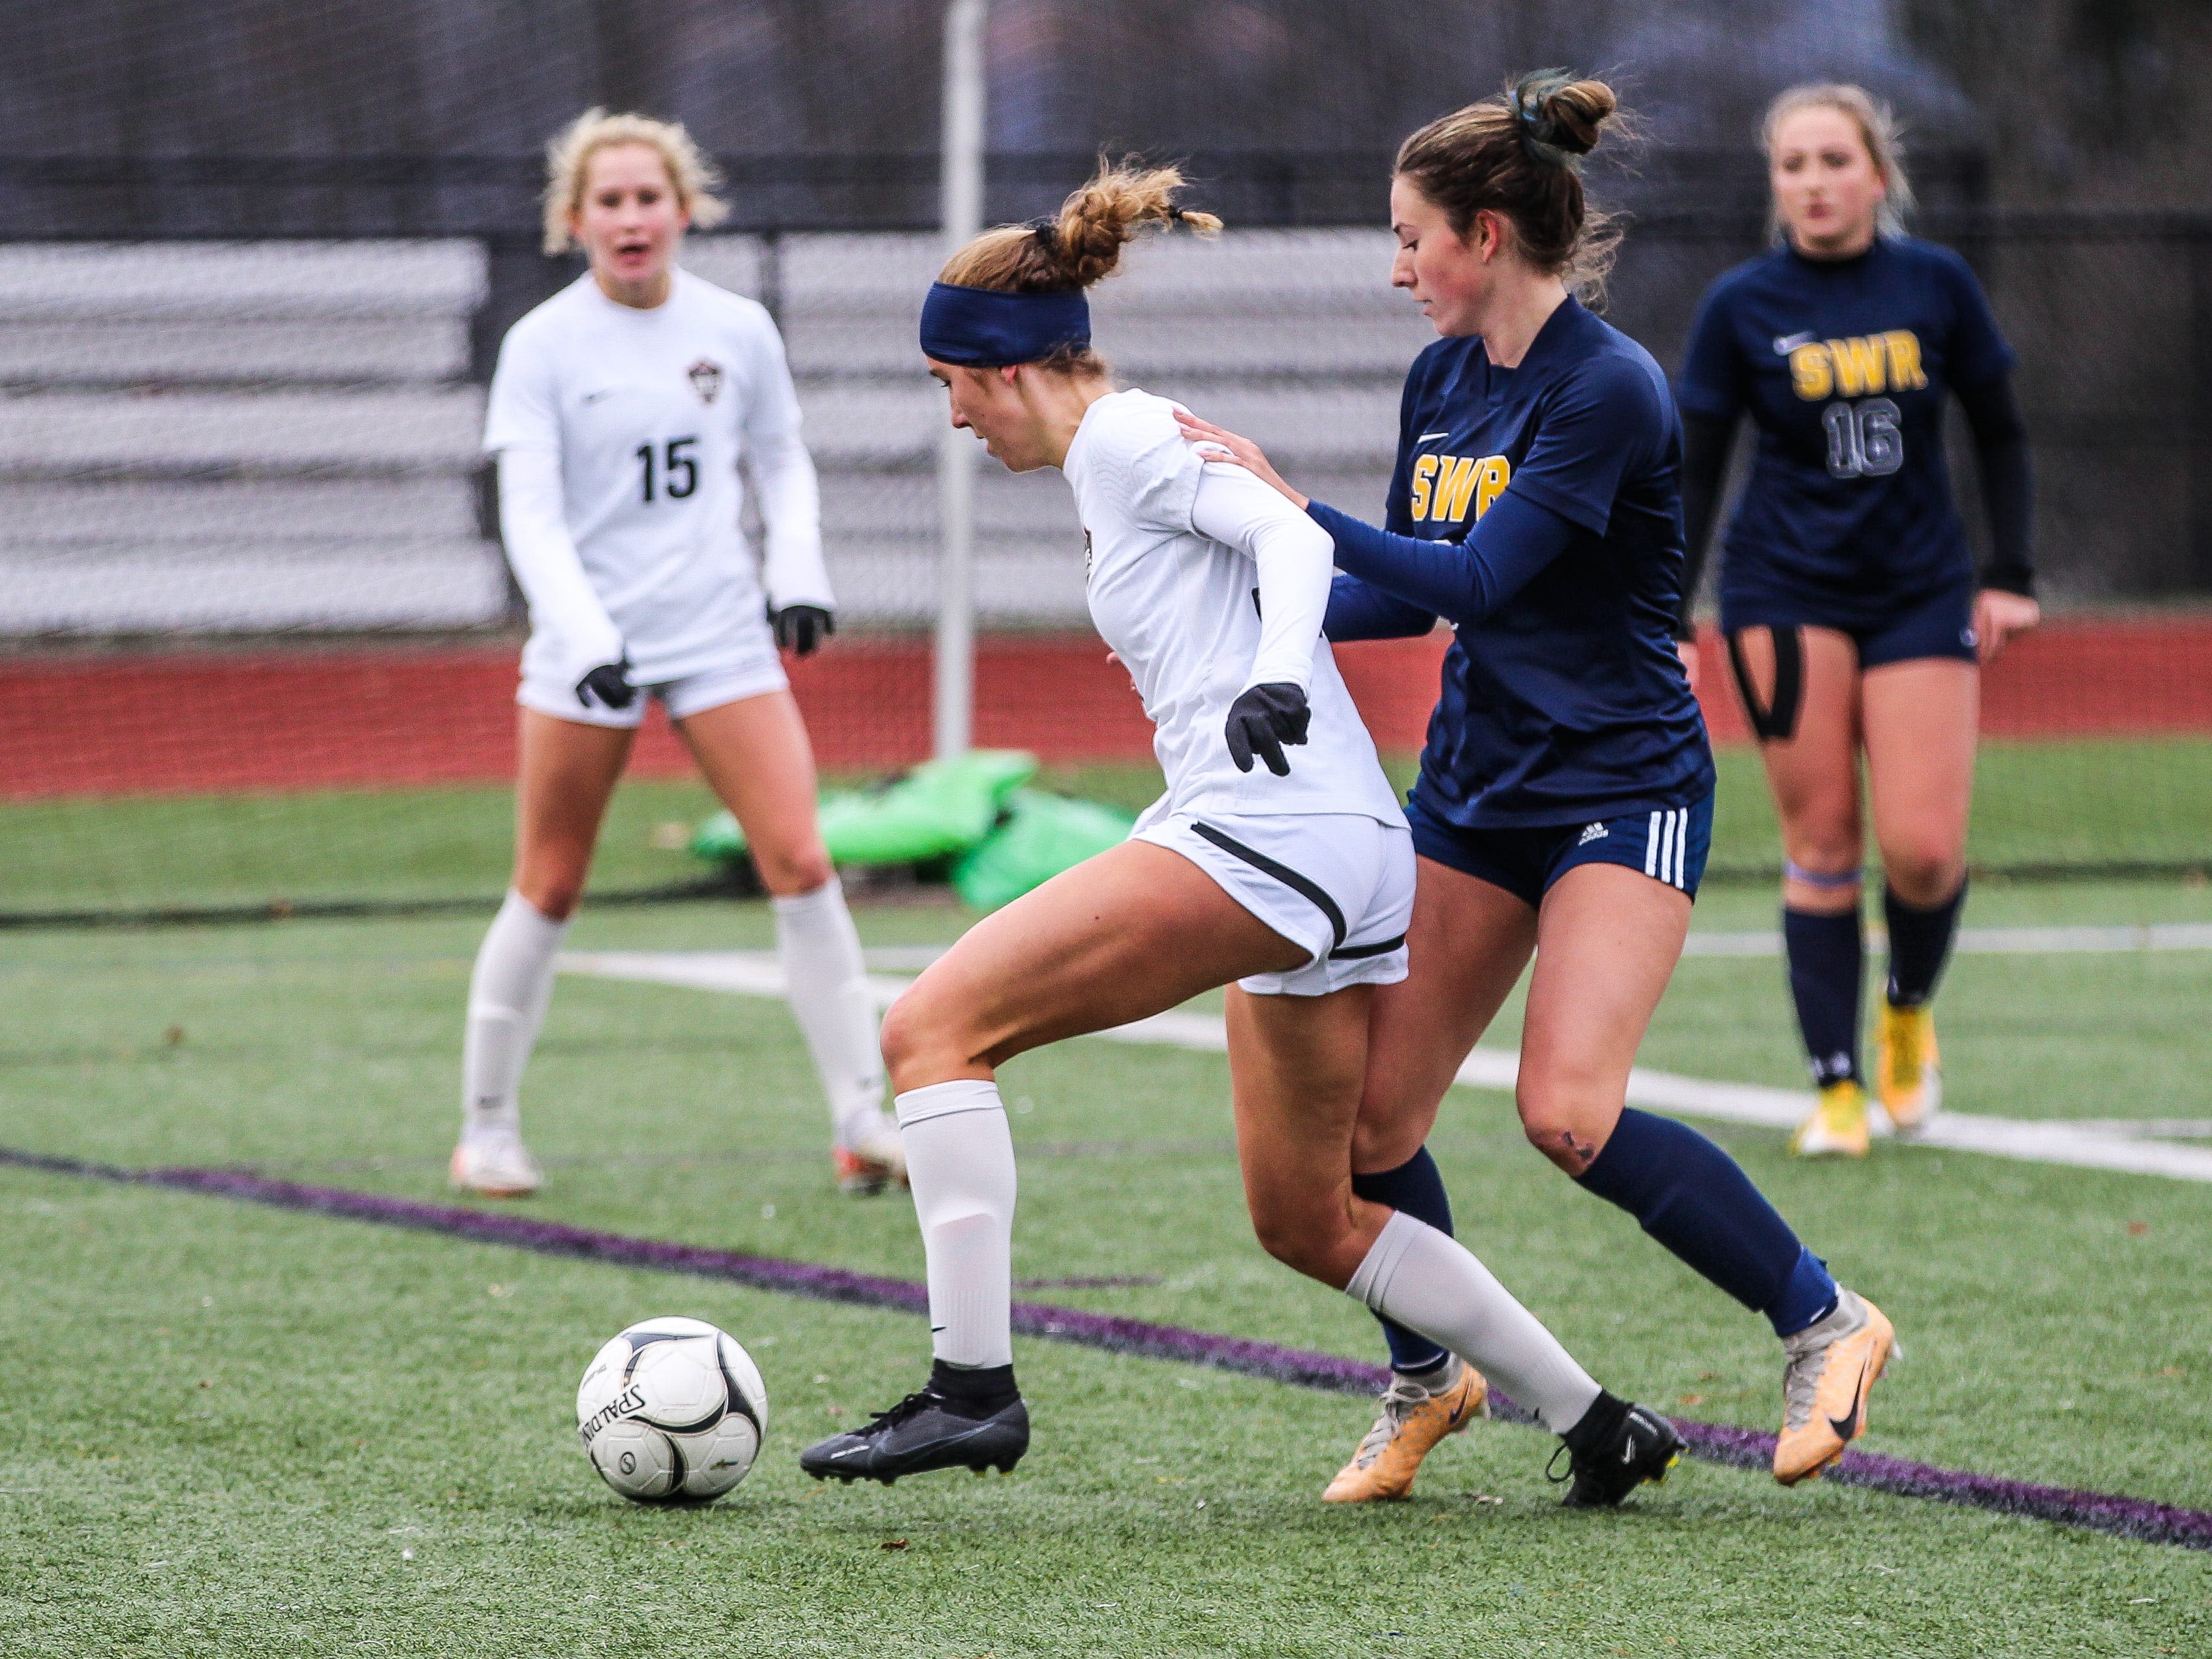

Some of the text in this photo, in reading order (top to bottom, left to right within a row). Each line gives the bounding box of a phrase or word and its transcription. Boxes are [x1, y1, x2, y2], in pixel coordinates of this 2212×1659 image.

[1789, 329, 1929, 402] SWR
[635, 436, 698, 502] 15
[1821, 398, 1903, 479] 16
[581, 1383, 646, 1446] SPALDIN
